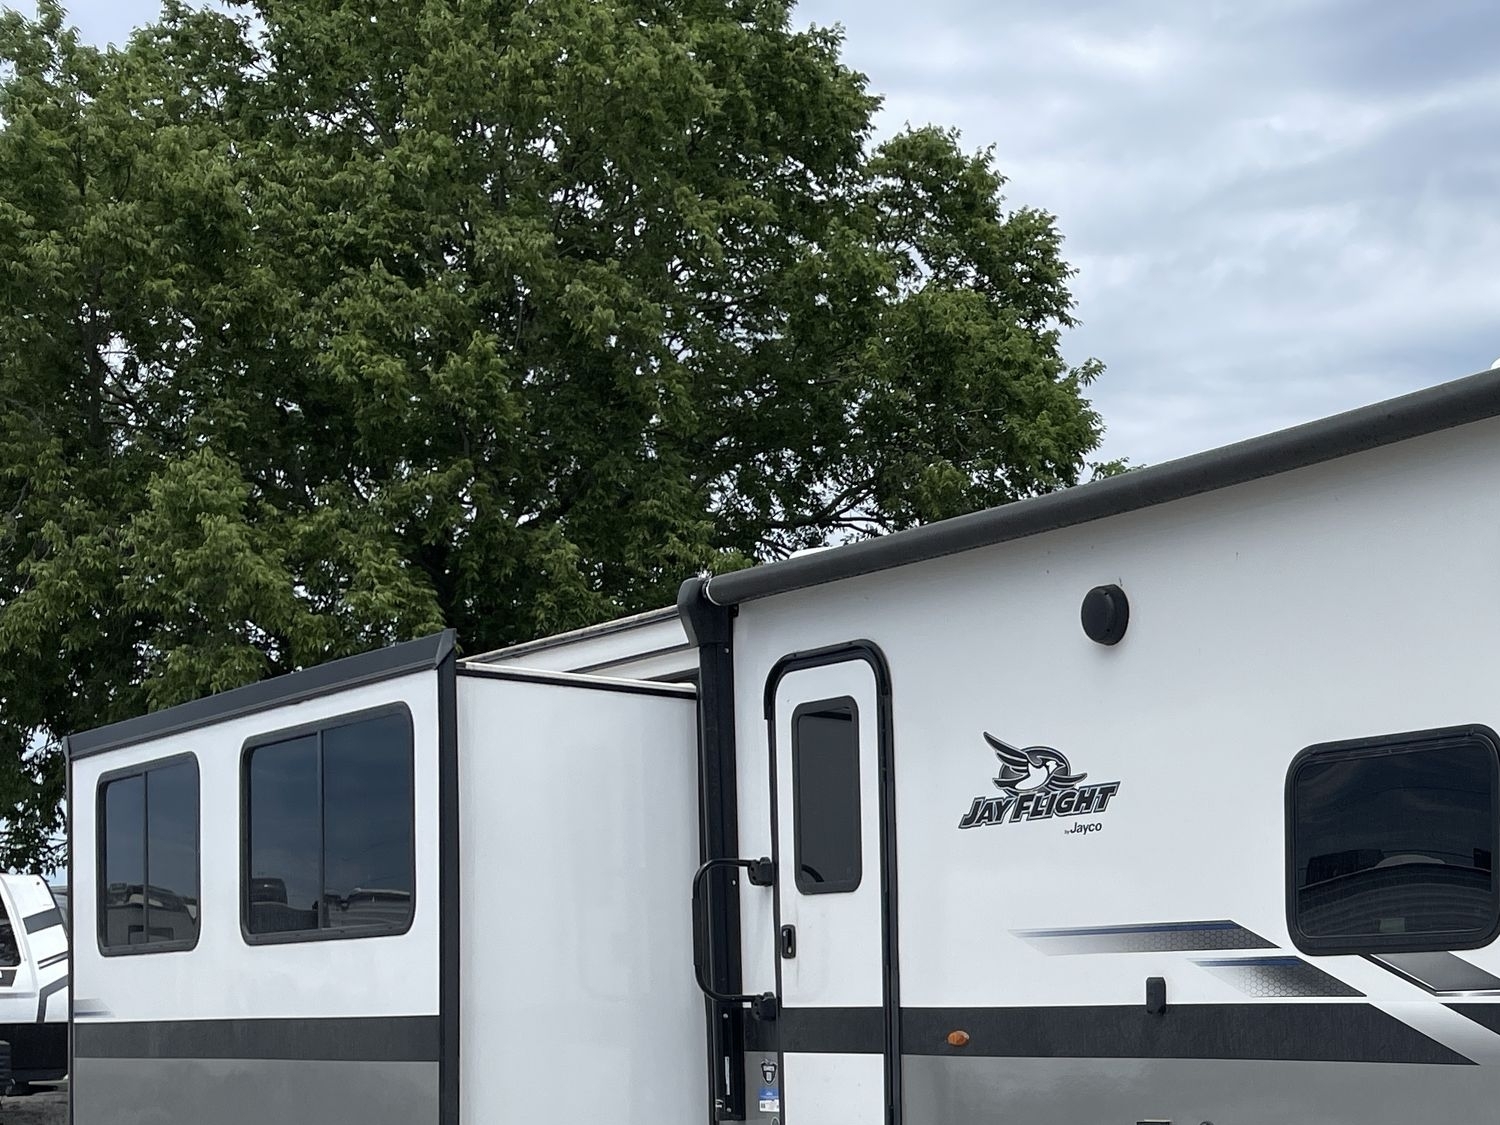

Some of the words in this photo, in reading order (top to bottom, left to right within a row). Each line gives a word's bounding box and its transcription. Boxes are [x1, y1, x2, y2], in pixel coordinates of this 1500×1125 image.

[958, 796, 1013, 829] JAY
[1009, 781, 1121, 823] FLIGHT
[1070, 822, 1102, 835] Jayco
